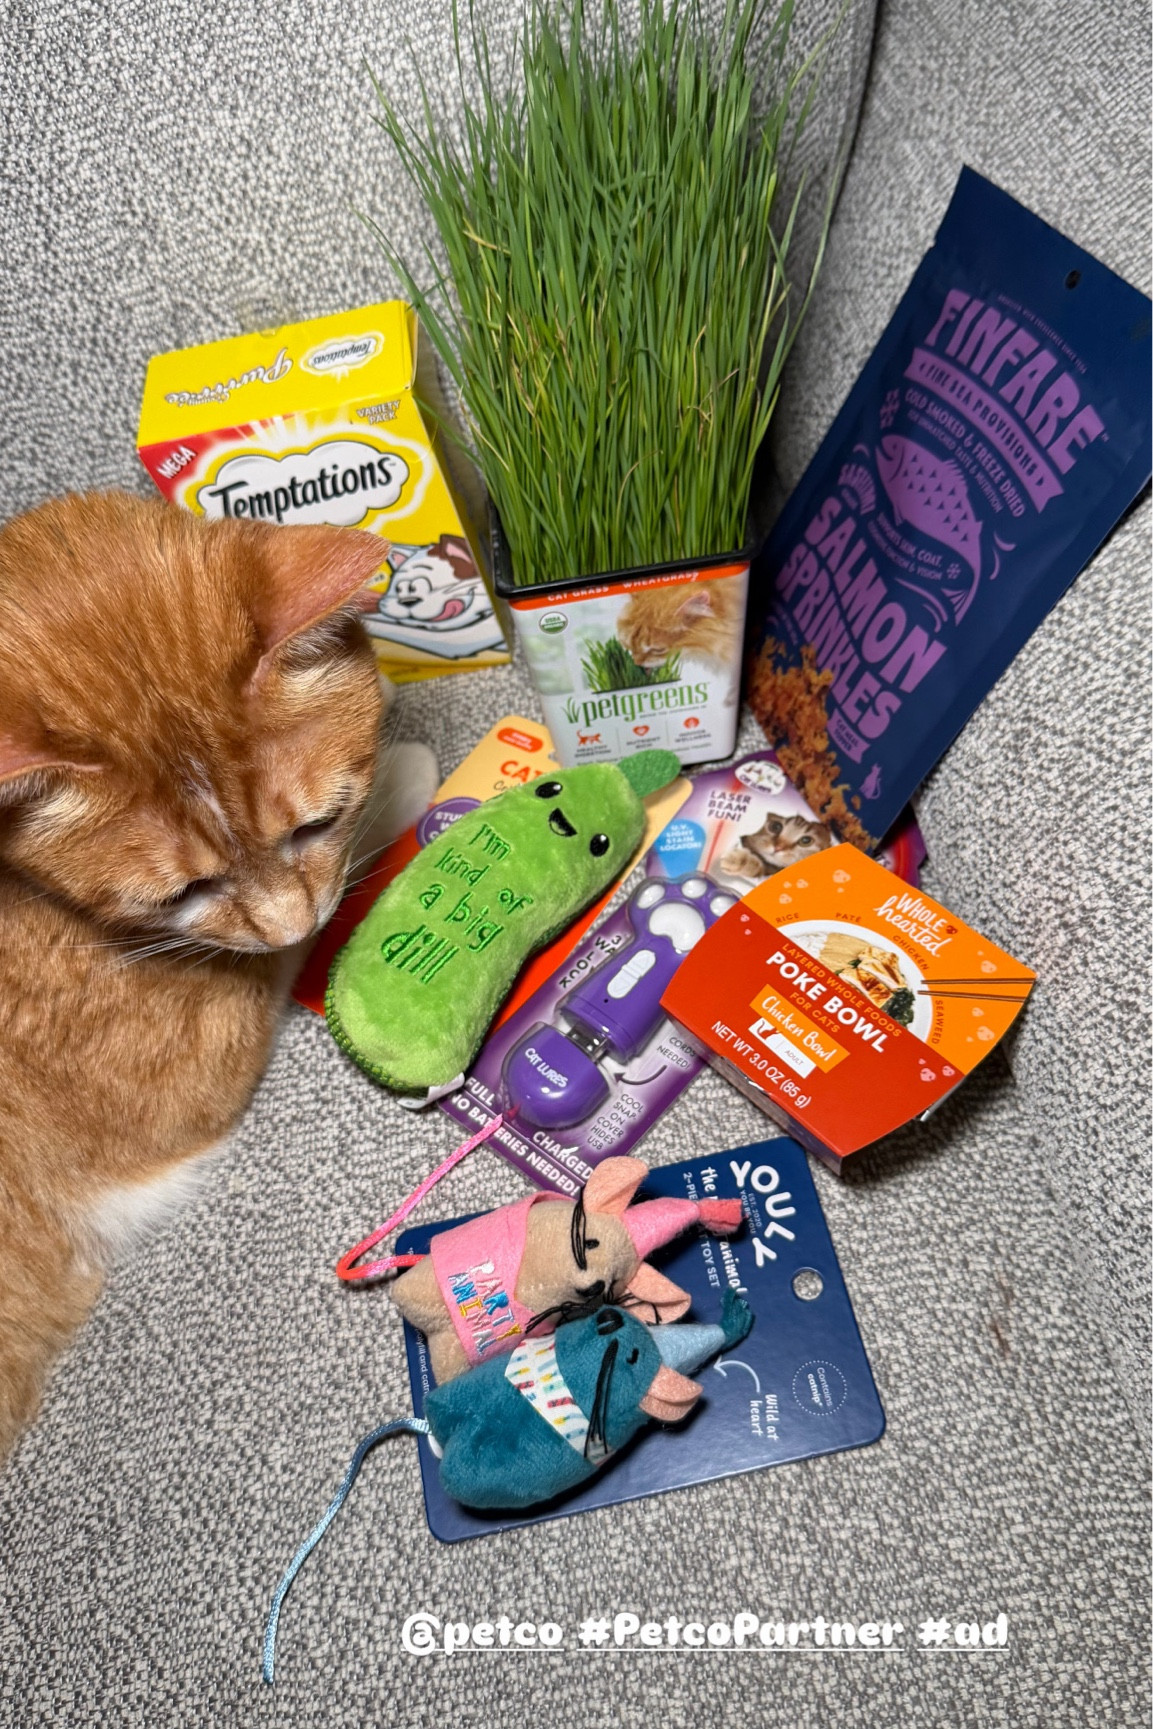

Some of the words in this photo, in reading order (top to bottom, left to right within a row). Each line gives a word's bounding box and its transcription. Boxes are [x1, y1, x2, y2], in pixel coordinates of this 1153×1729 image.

[923, 289, 1105, 475] FINFARE
[356, 400, 401, 419] VARIETY
[367, 411, 397, 426] PACK
[925, 364, 951, 388] FINE
[949, 380, 973, 406] SEA
[972, 399, 1038, 478] PROVISIONS
[156, 445, 196, 480] MEGA
[905, 388, 929, 410] COLD
[925, 402, 967, 440] SMOKED
[963, 433, 975, 449] &
[972, 441, 1006, 485] FREEZE
[999, 479, 1026, 518] DRIED
[207, 457, 393, 523] Temptations
[975, 471, 1004, 514] NUTRITION
[547, 592, 568, 602] CAT
[803, 496, 948, 694] SALMON
[776, 542, 901, 740] SPRINKLES
[581, 681, 708, 727] petgreens
[706, 810, 742, 822] FUN!
[707, 799, 748, 813] BEAM
[710, 789, 752, 805] LASER
[469, 823, 511, 861] I'm
[434, 847, 491, 887] kind
[497, 889, 535, 914] of
[418, 883, 446, 910] a
[443, 892, 505, 954] big
[775, 912, 800, 924] RICE
[895, 892, 947, 932] WHOLE
[380, 925, 460, 984] dill
[892, 934, 930, 971] CHICKEN
[765, 951, 827, 1001] POKE
[822, 995, 888, 1053] BOWL
[781, 942, 826, 978] LAYERED
[825, 975, 865, 1009] WHOLE
[863, 1007, 902, 1037] FOODS
[760, 995, 805, 1037] Chicken
[802, 1031, 837, 1061] Bowl
[788, 991, 812, 1011] FOR
[810, 1009, 840, 1033] CATS
[931, 998, 944, 1045] SEAWEED
[656, 1044, 692, 1070] NEEDED!
[668, 1036, 697, 1057] CORDS
[711, 1020, 738, 1043] NET
[732, 1037, 754, 1057] WT
[748, 1052, 769, 1071] 3.0
[764, 1065, 785, 1085] OZ
[779, 1078, 801, 1099] (85
[794, 1090, 812, 1109] g)
[782, 1049, 805, 1067] ADULT
[524, 1046, 543, 1066] CAT
[537, 1058, 570, 1089] LURES
[609, 1111, 626, 1125] ON
[620, 1093, 645, 1113] COOL
[586, 1135, 604, 1151] USB
[591, 1124, 617, 1145] HIDES
[596, 1115, 625, 1138] COVER
[525, 1150, 581, 1198] NEEDED!
[532, 1130, 596, 1181] CHARGED
[700, 1166, 719, 1193] the
[739, 1189, 750, 1207] YOU
[747, 1215, 757, 1235] YOU
[751, 1207, 763, 1228] 2020
[700, 1240, 715, 1264] TOY
[706, 1265, 722, 1290] SET
[448, 1271, 499, 1356] ANIMAL
[466, 1260, 522, 1341] PARTY
[420, 1354, 429, 1373] and
[816, 1366, 834, 1407] Contains
[749, 1400, 764, 1437] heart
[765, 1394, 780, 1422] Wild
[766, 1425, 780, 1441] at
